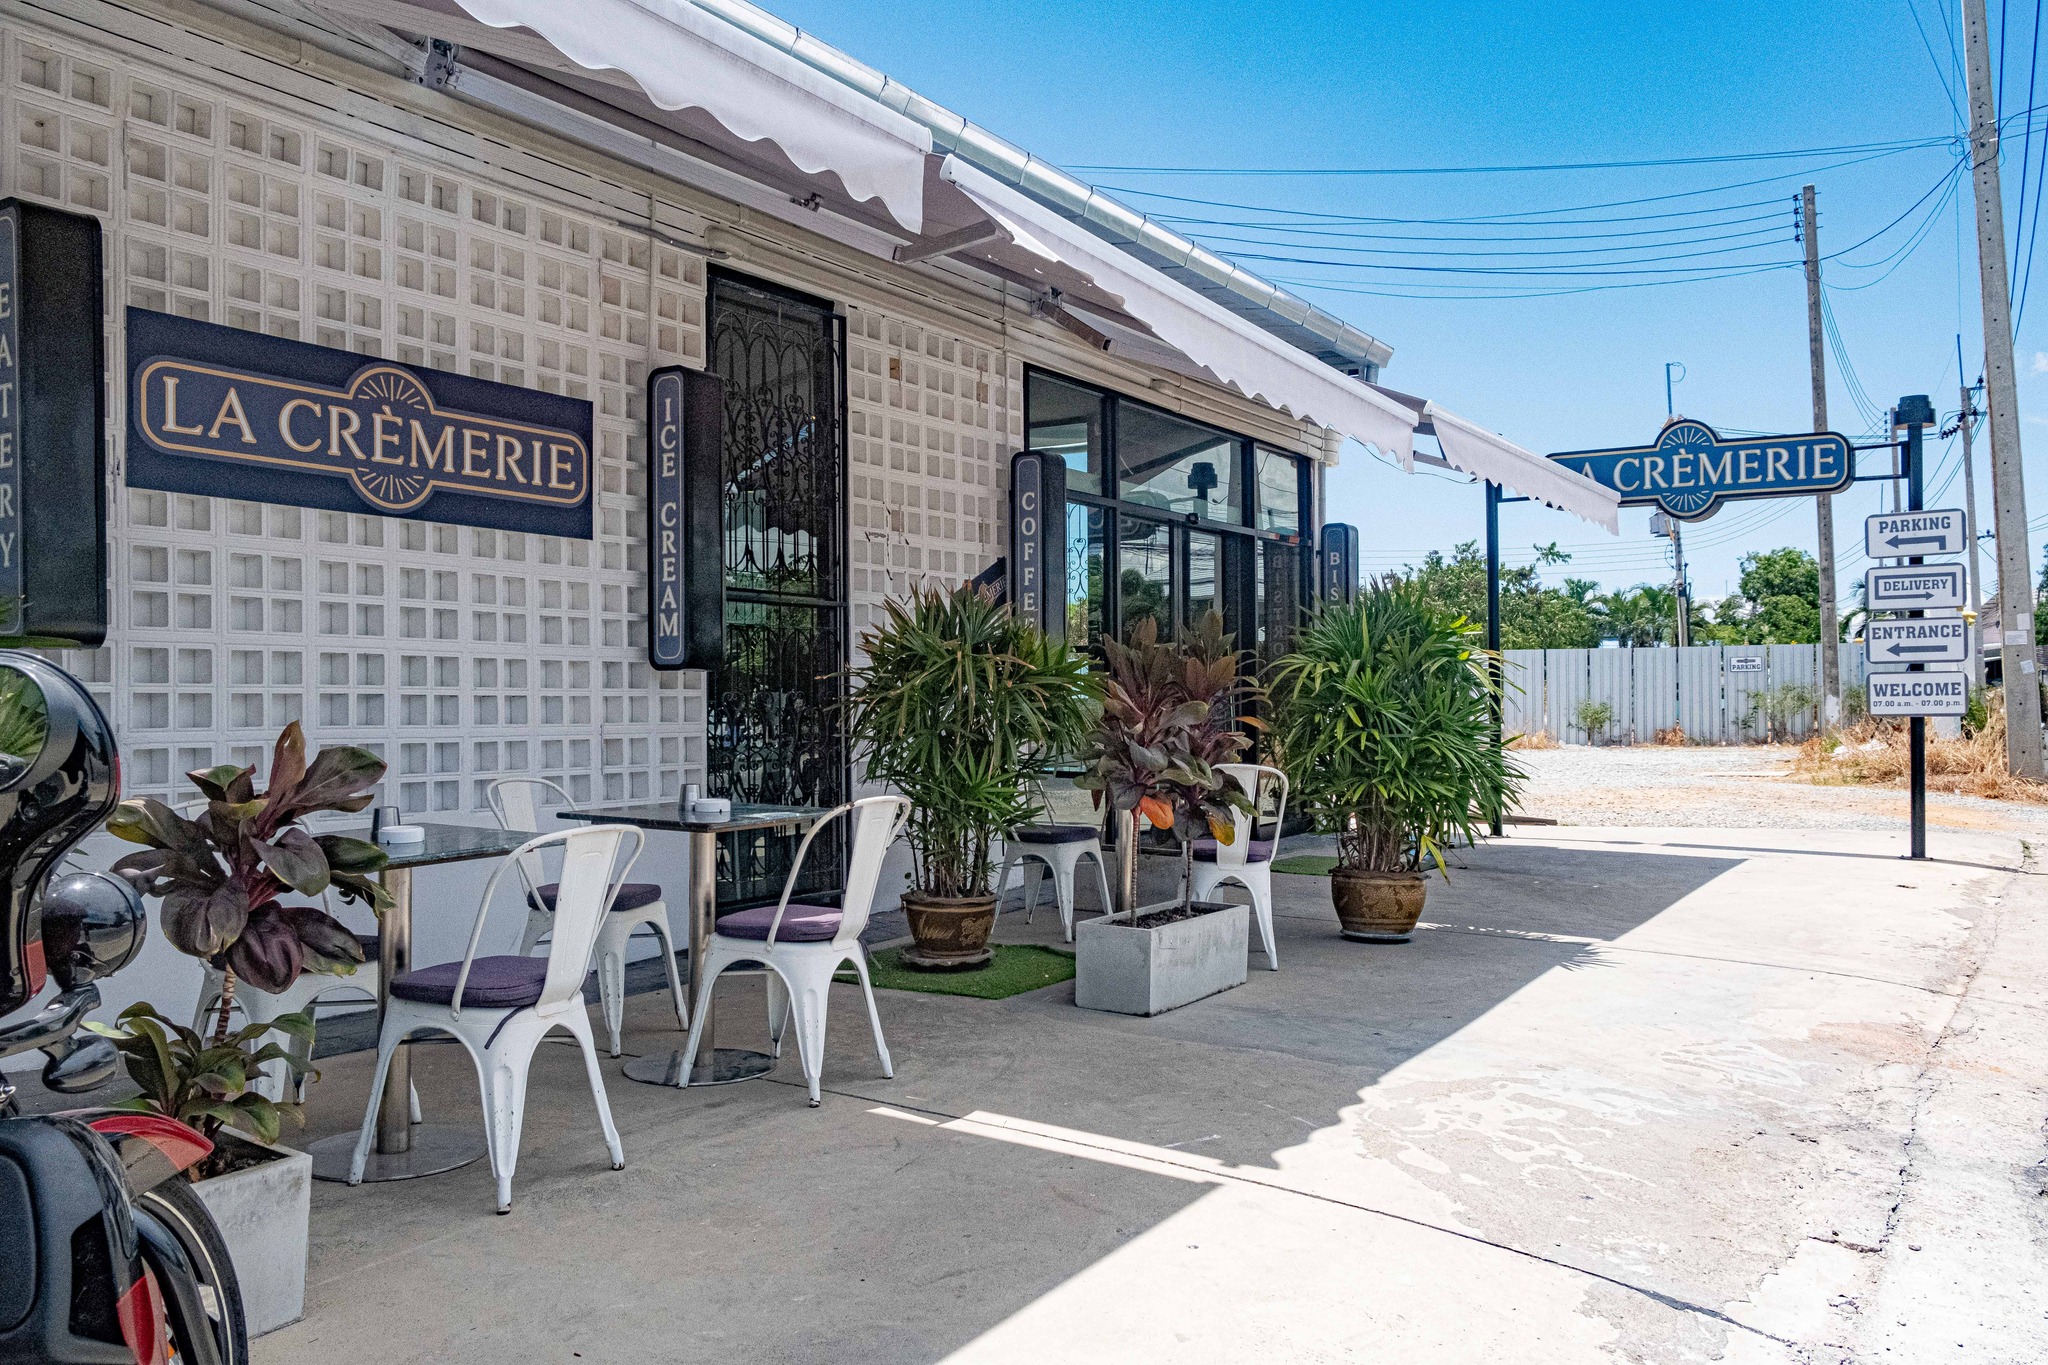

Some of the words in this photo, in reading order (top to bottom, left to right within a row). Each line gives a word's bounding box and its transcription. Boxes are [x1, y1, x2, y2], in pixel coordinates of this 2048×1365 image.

[0, 282, 15, 568] EATERY
[162, 375, 257, 444] LA
[278, 398, 576, 491] CRÈMERIE
[660, 397, 677, 478] ICE
[1613, 443, 1838, 491] CRÈMERIE
[1879, 516, 1951, 534] PARKING
[659, 501, 679, 637] CREAM
[1329, 552, 1341, 614] BIST
[1883, 579, 1949, 592] DELIVERY
[1872, 624, 1962, 640] ENTRANCE
[1873, 682, 1962, 697] WELCOME
[1946, 700, 1963, 708] p.m.
